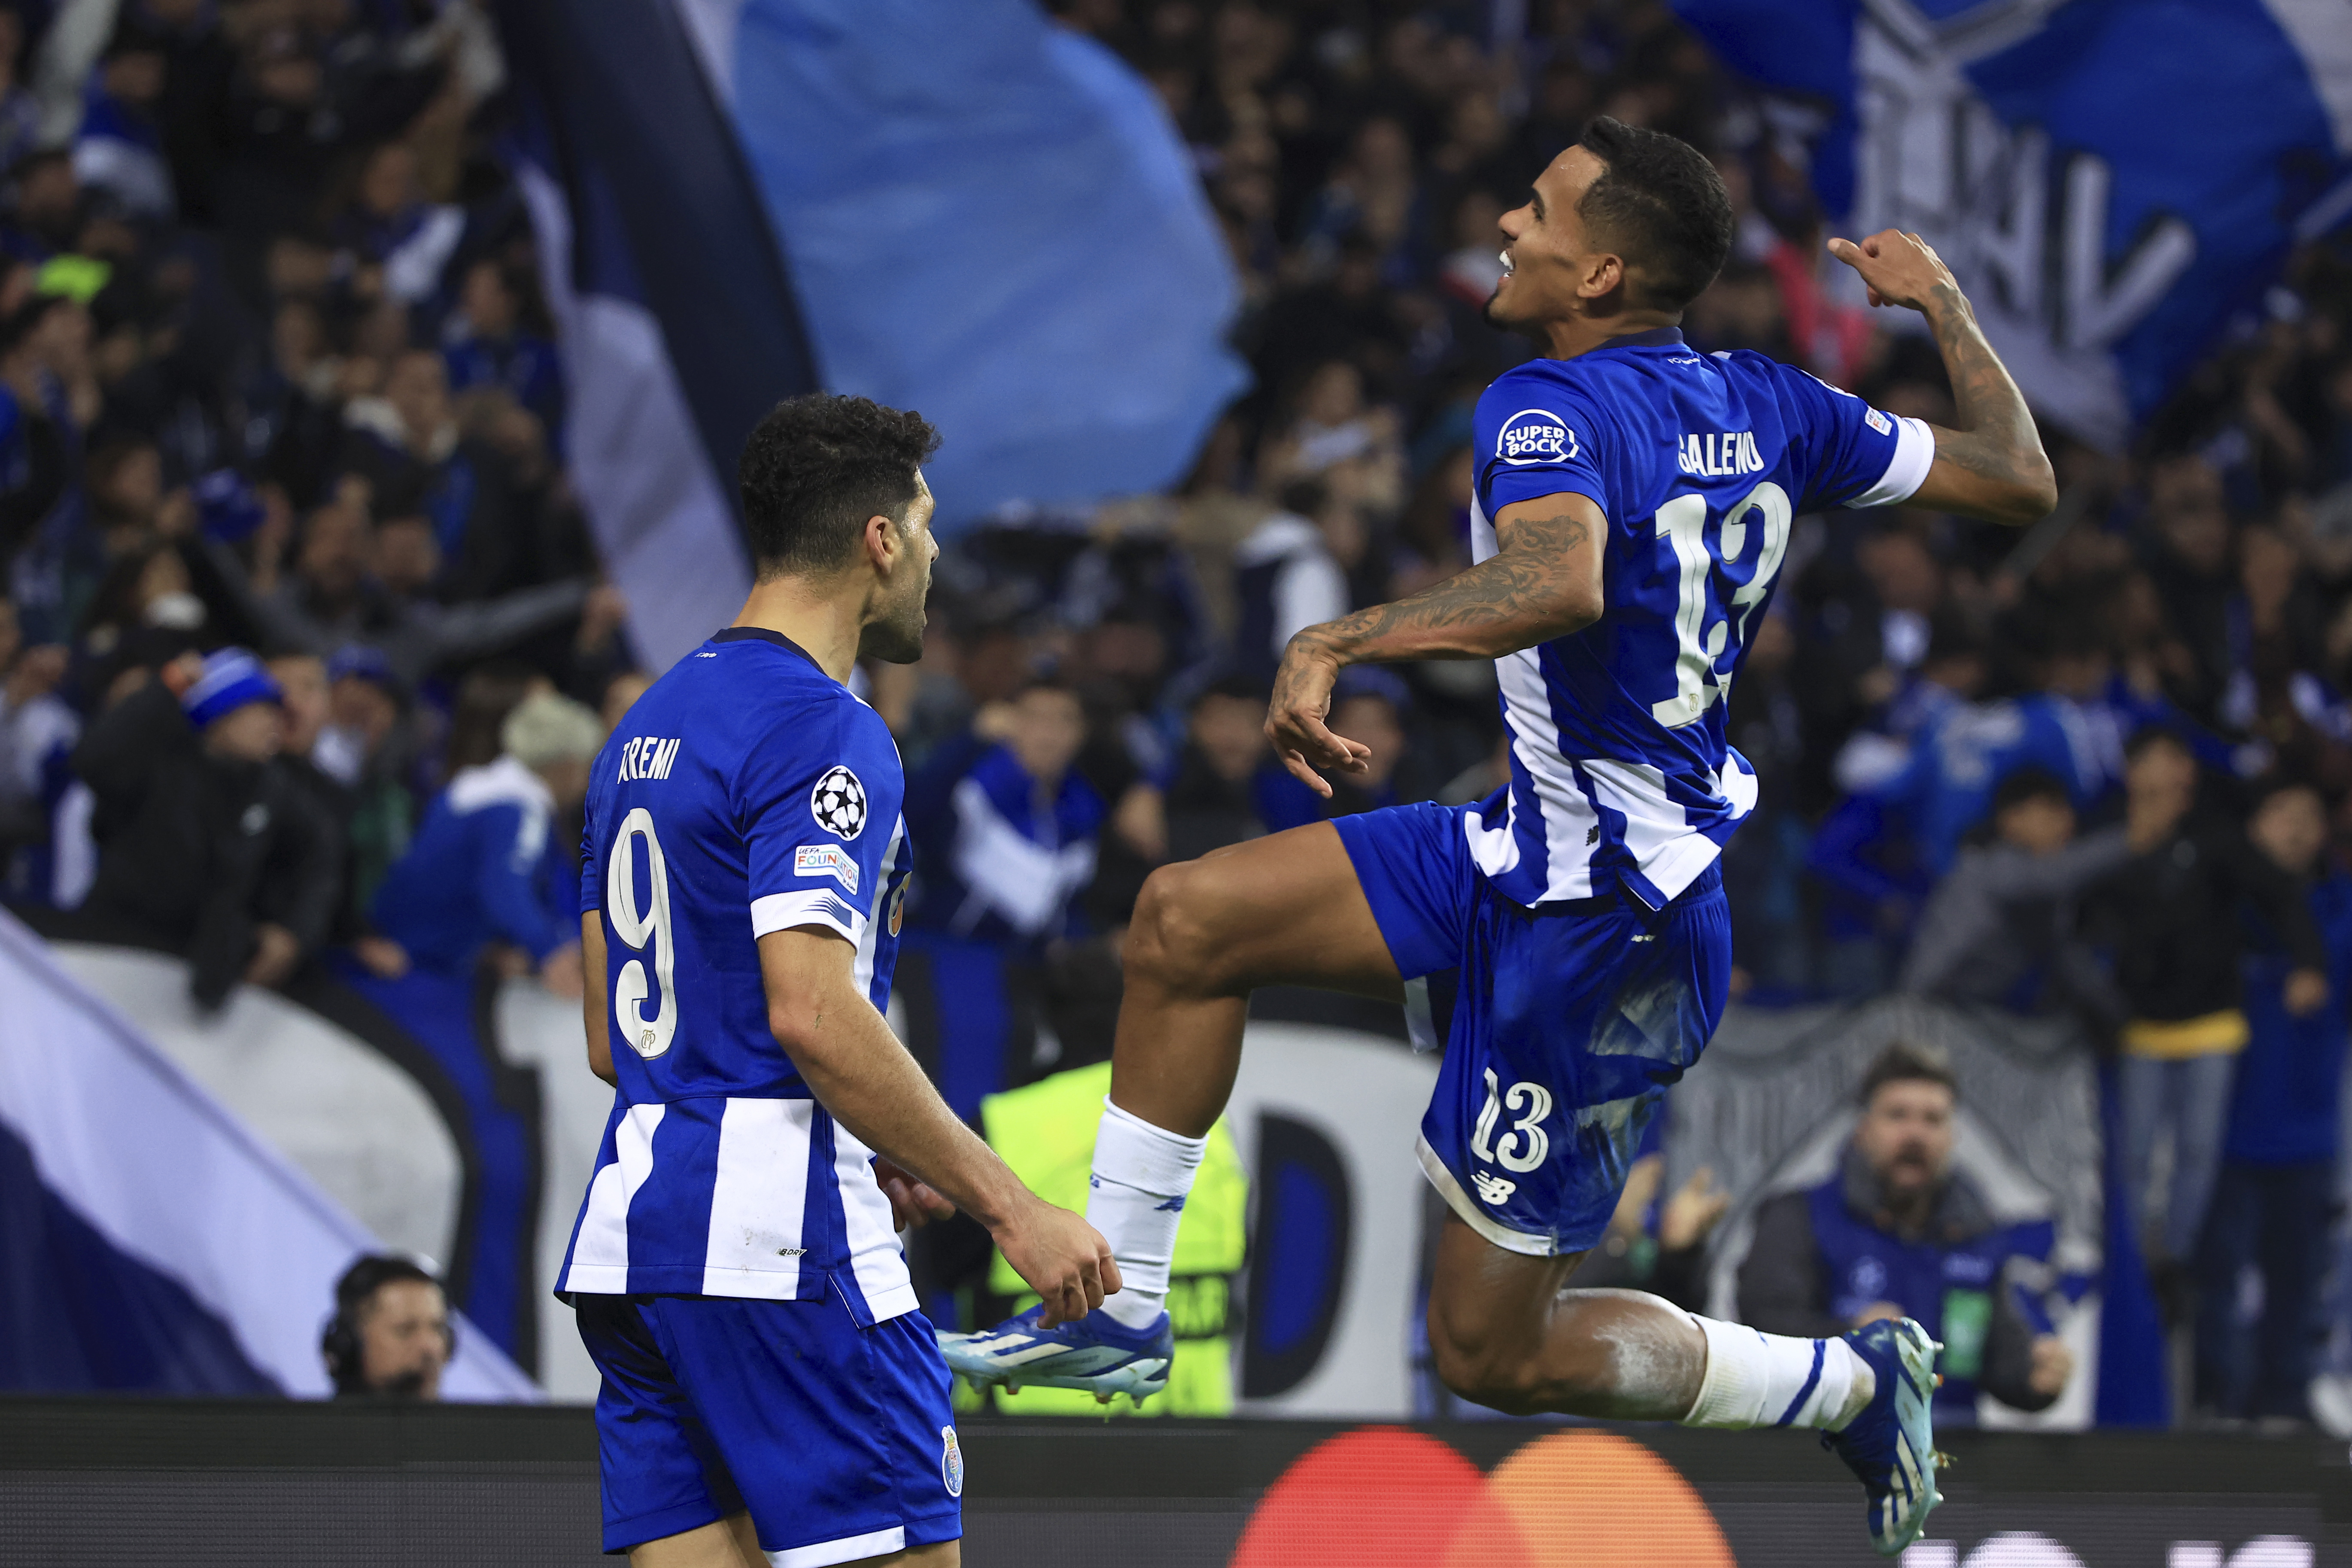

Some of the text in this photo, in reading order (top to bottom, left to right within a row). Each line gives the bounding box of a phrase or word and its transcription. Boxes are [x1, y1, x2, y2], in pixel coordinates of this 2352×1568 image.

[1505, 425, 1566, 447] SUPER
[1508, 438, 1564, 457] BOCK
[1678, 431, 1765, 477] GALENO
[1652, 481, 1792, 729] 13
[798, 854, 857, 884] FOUNDATION
[608, 808, 678, 1059] 9
[1471, 1067, 1553, 1173] 13
